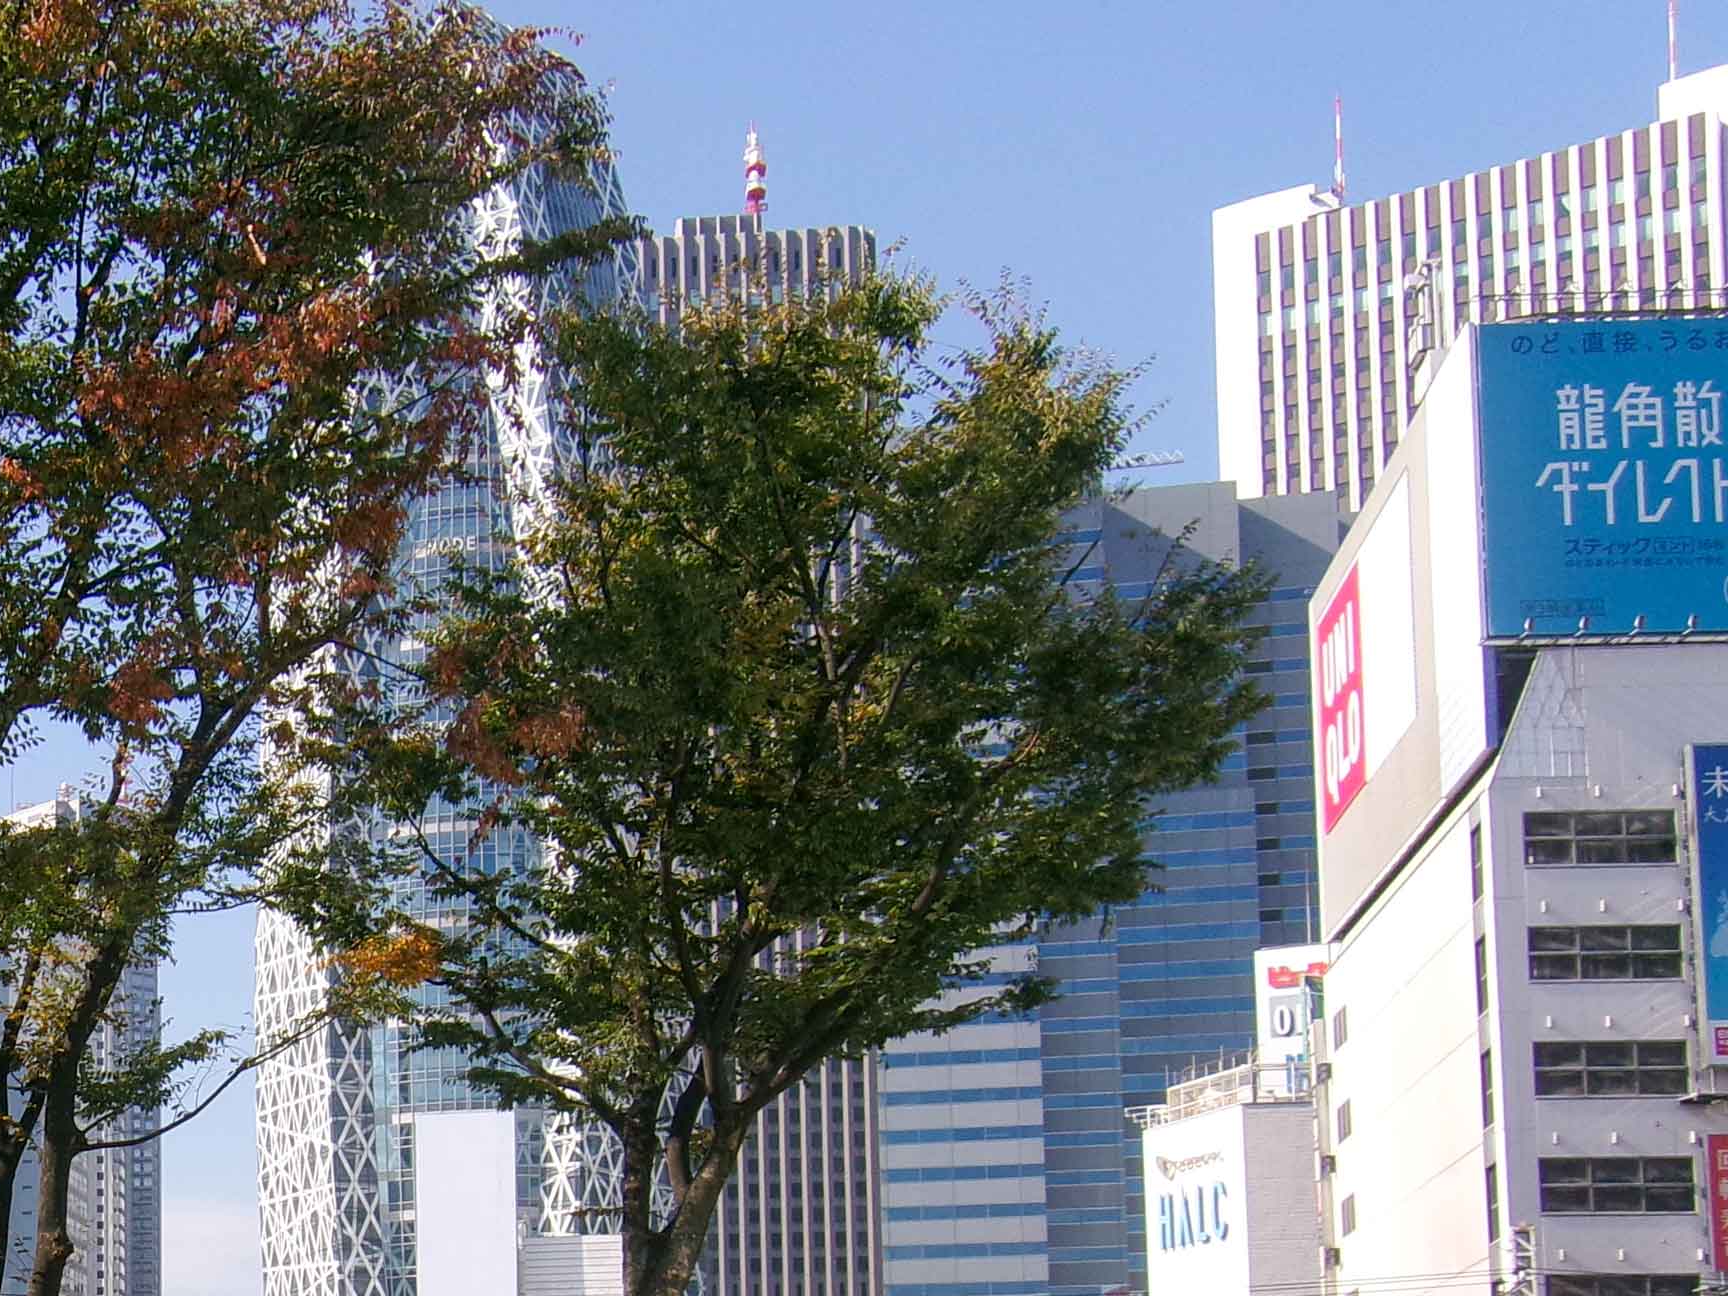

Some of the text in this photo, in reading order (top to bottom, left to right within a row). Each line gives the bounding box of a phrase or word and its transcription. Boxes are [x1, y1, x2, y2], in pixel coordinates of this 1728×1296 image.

[1556, 380, 1722, 449] 龍角散
[1322, 601, 1356, 707] UNI
[1325, 690, 1361, 805] QLO
[1159, 1181, 1229, 1252] HALC
